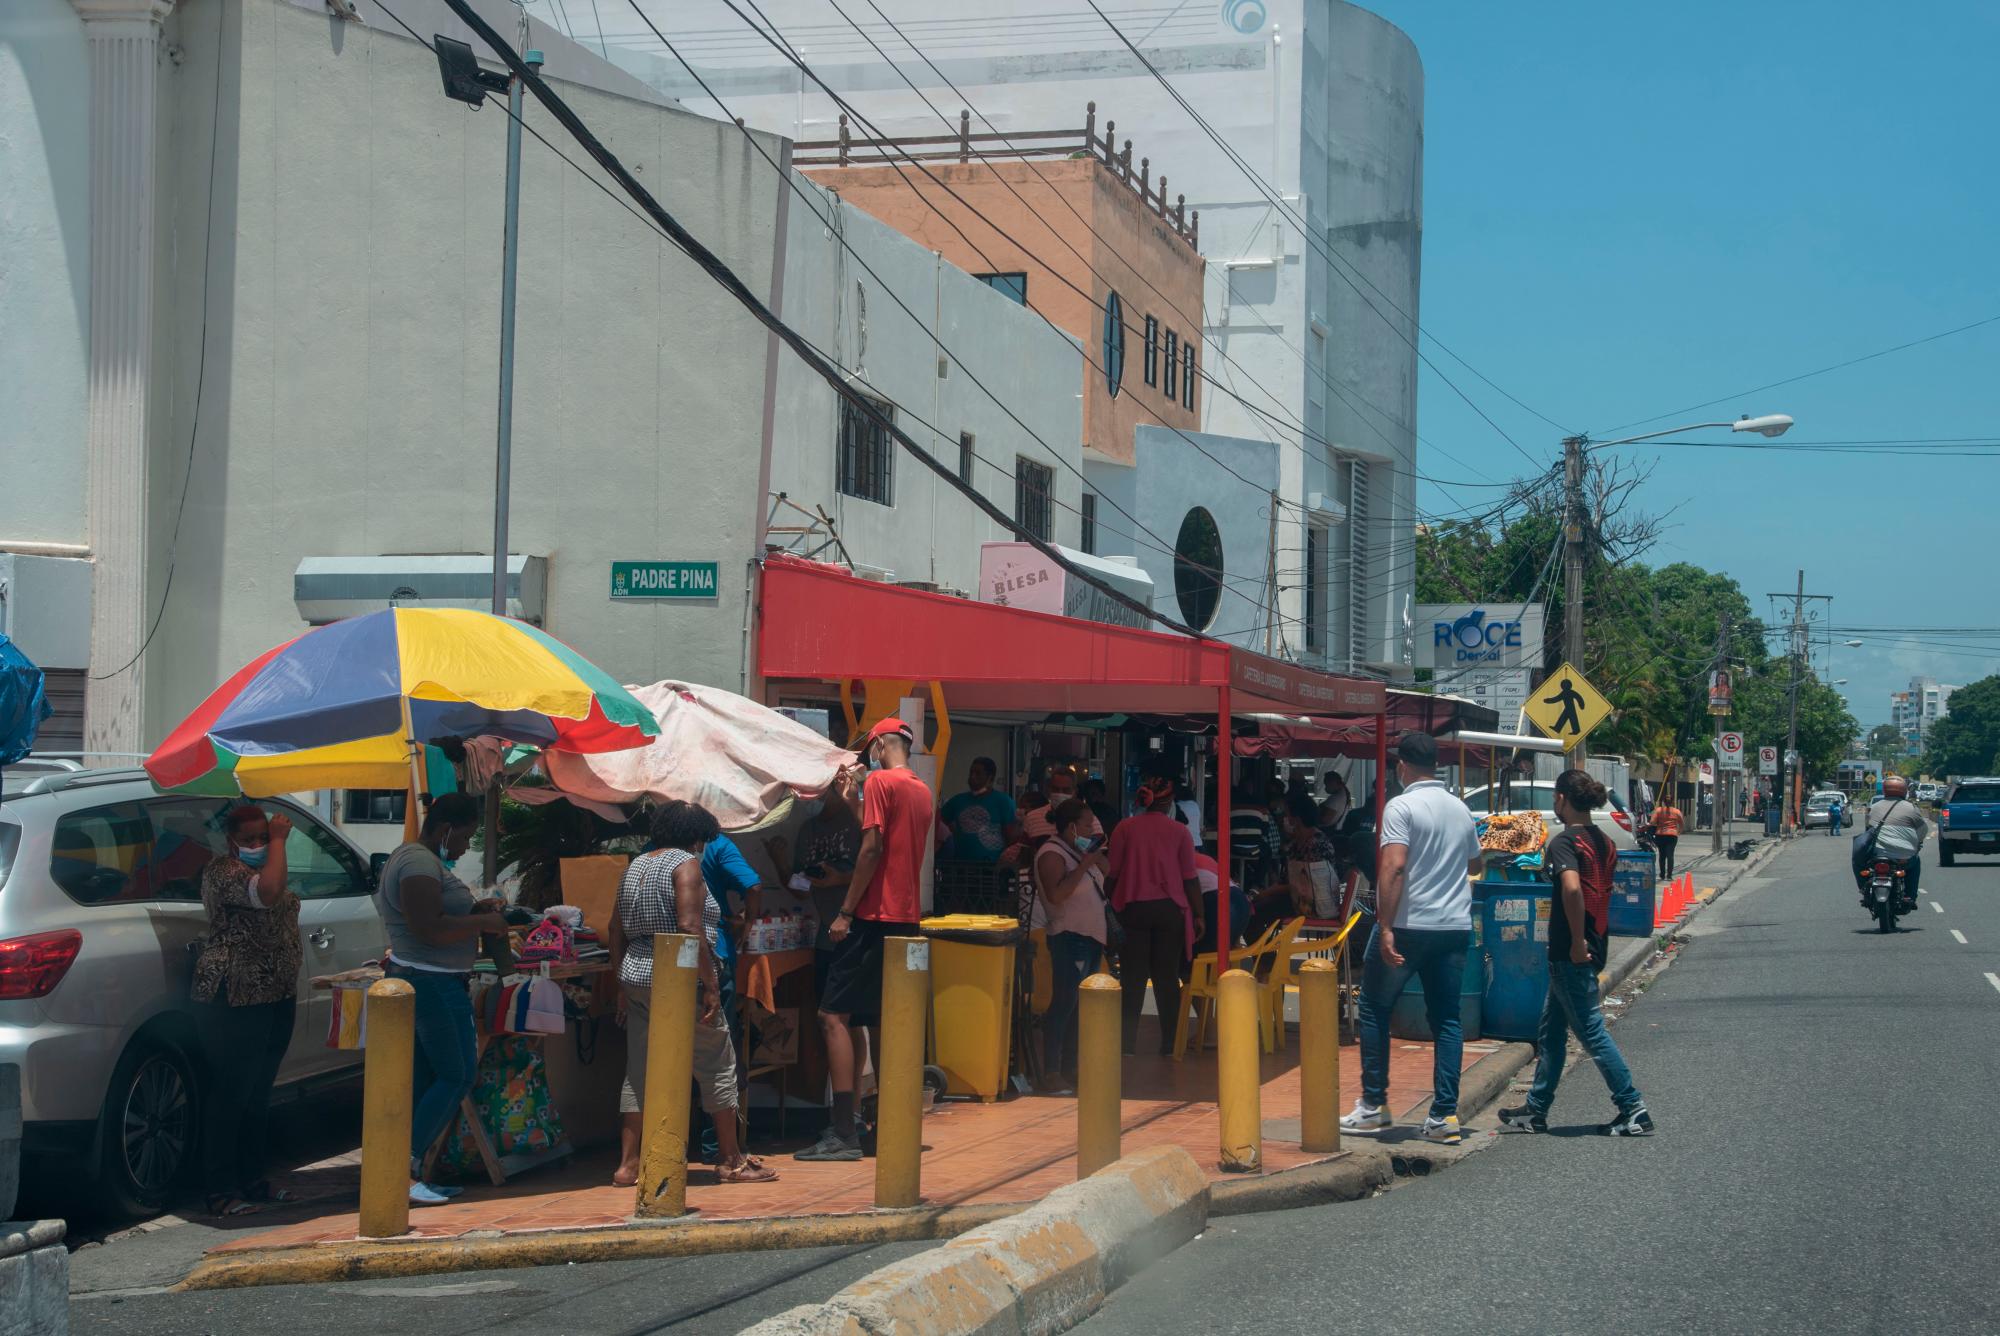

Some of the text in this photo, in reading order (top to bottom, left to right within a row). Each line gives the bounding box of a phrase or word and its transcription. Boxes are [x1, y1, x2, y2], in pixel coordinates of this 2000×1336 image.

[631, 568, 714, 589] PADRE PINA
[994, 569, 1049, 595] BLESA
[613, 588, 629, 596] ADN
[1434, 611, 1522, 648] ROCE
